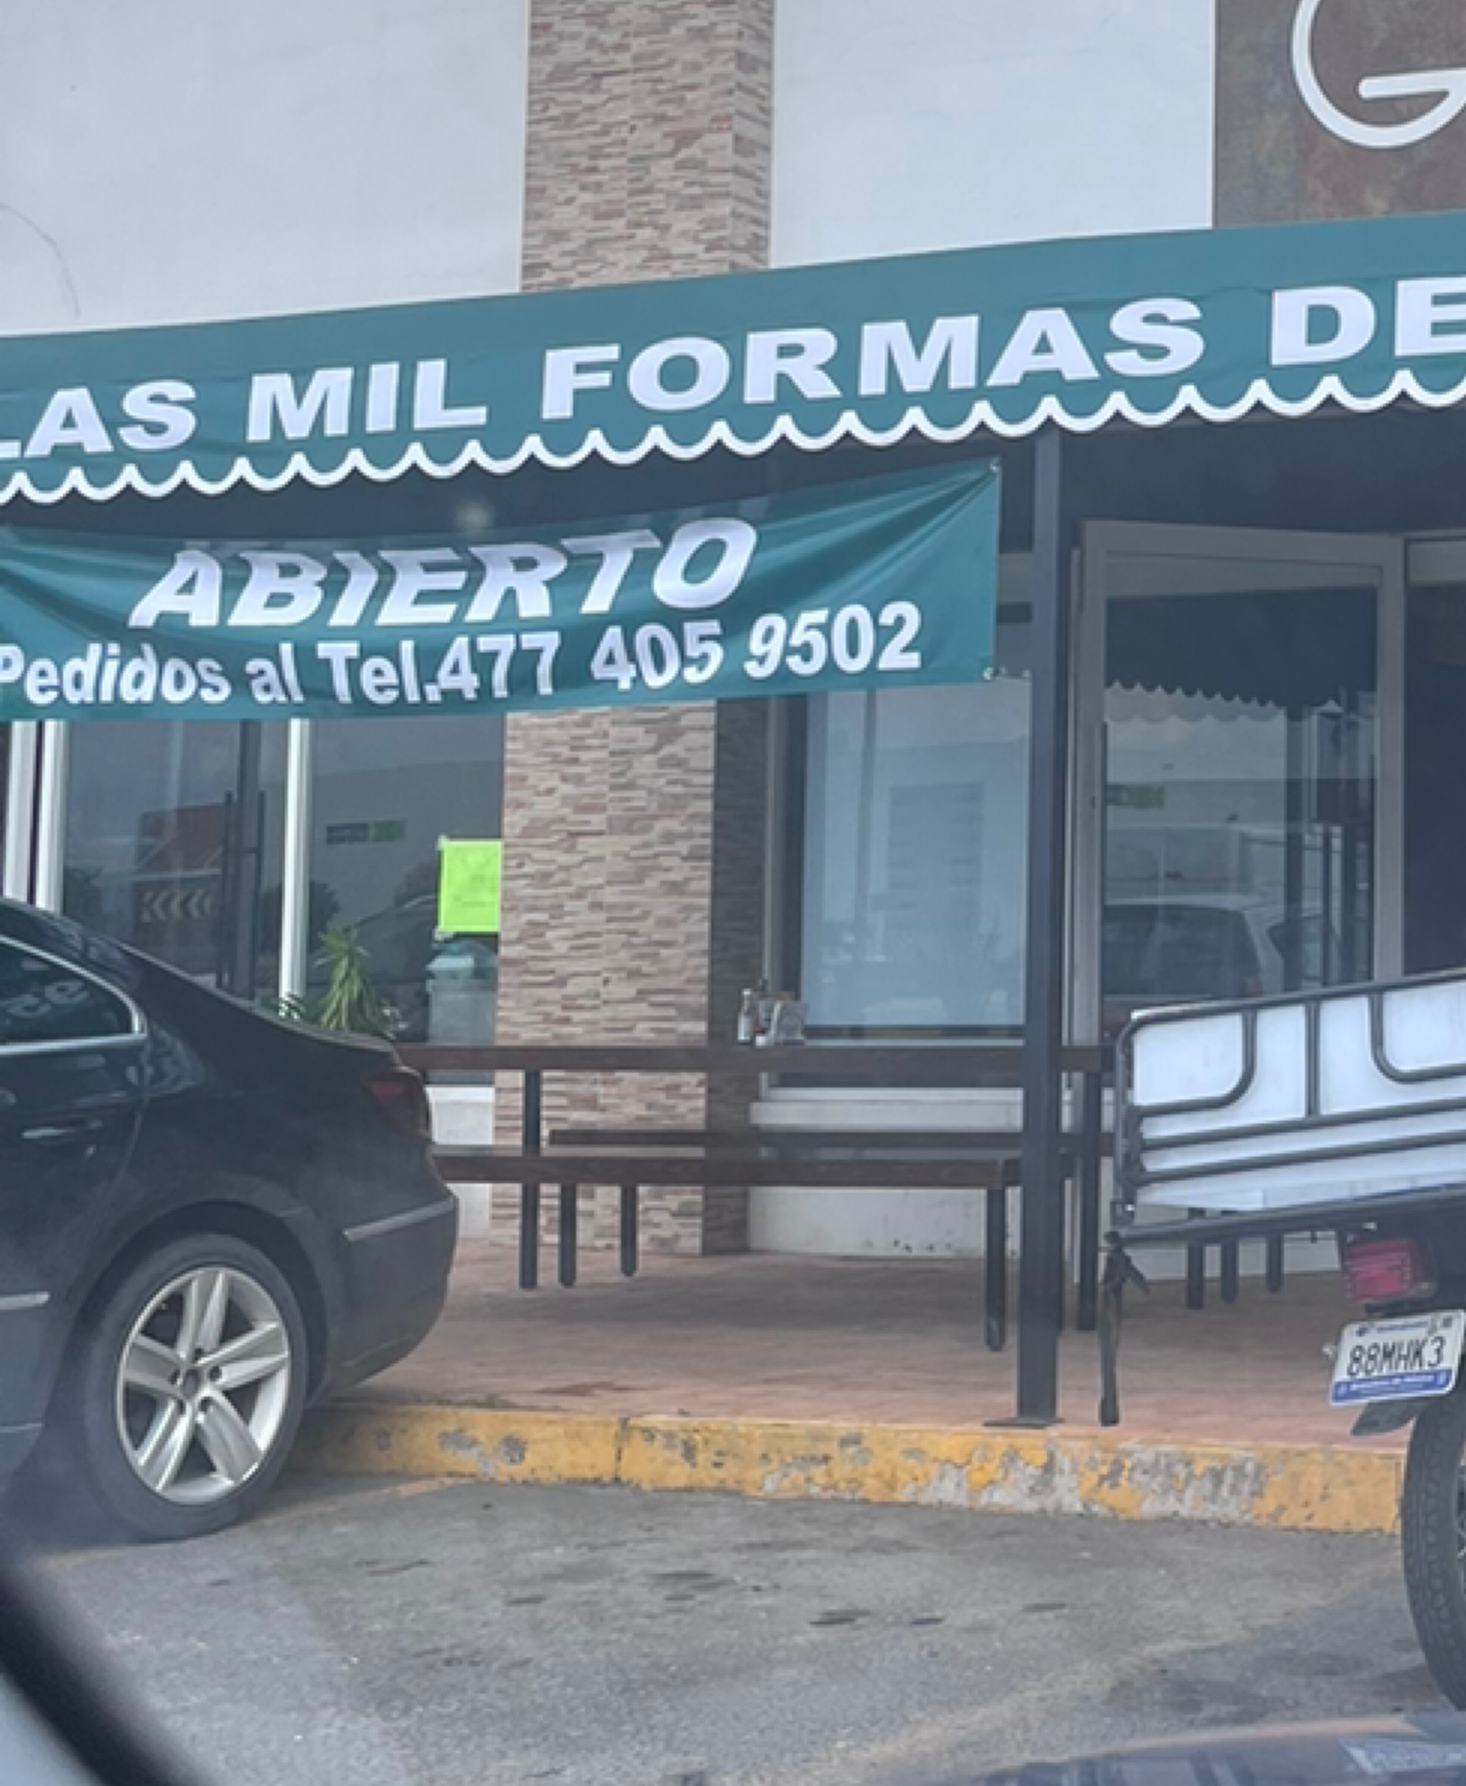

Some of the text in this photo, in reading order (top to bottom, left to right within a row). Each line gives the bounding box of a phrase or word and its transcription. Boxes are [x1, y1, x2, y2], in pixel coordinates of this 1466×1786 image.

[246, 358, 488, 444] MIL
[541, 297, 1204, 420] FORMAS
[128, 517, 758, 628] ABIERTO
[0, 642, 232, 705] Pedidos
[245, 642, 304, 704] al
[590, 619, 724, 691] 405
[743, 601, 921, 678] 9502
